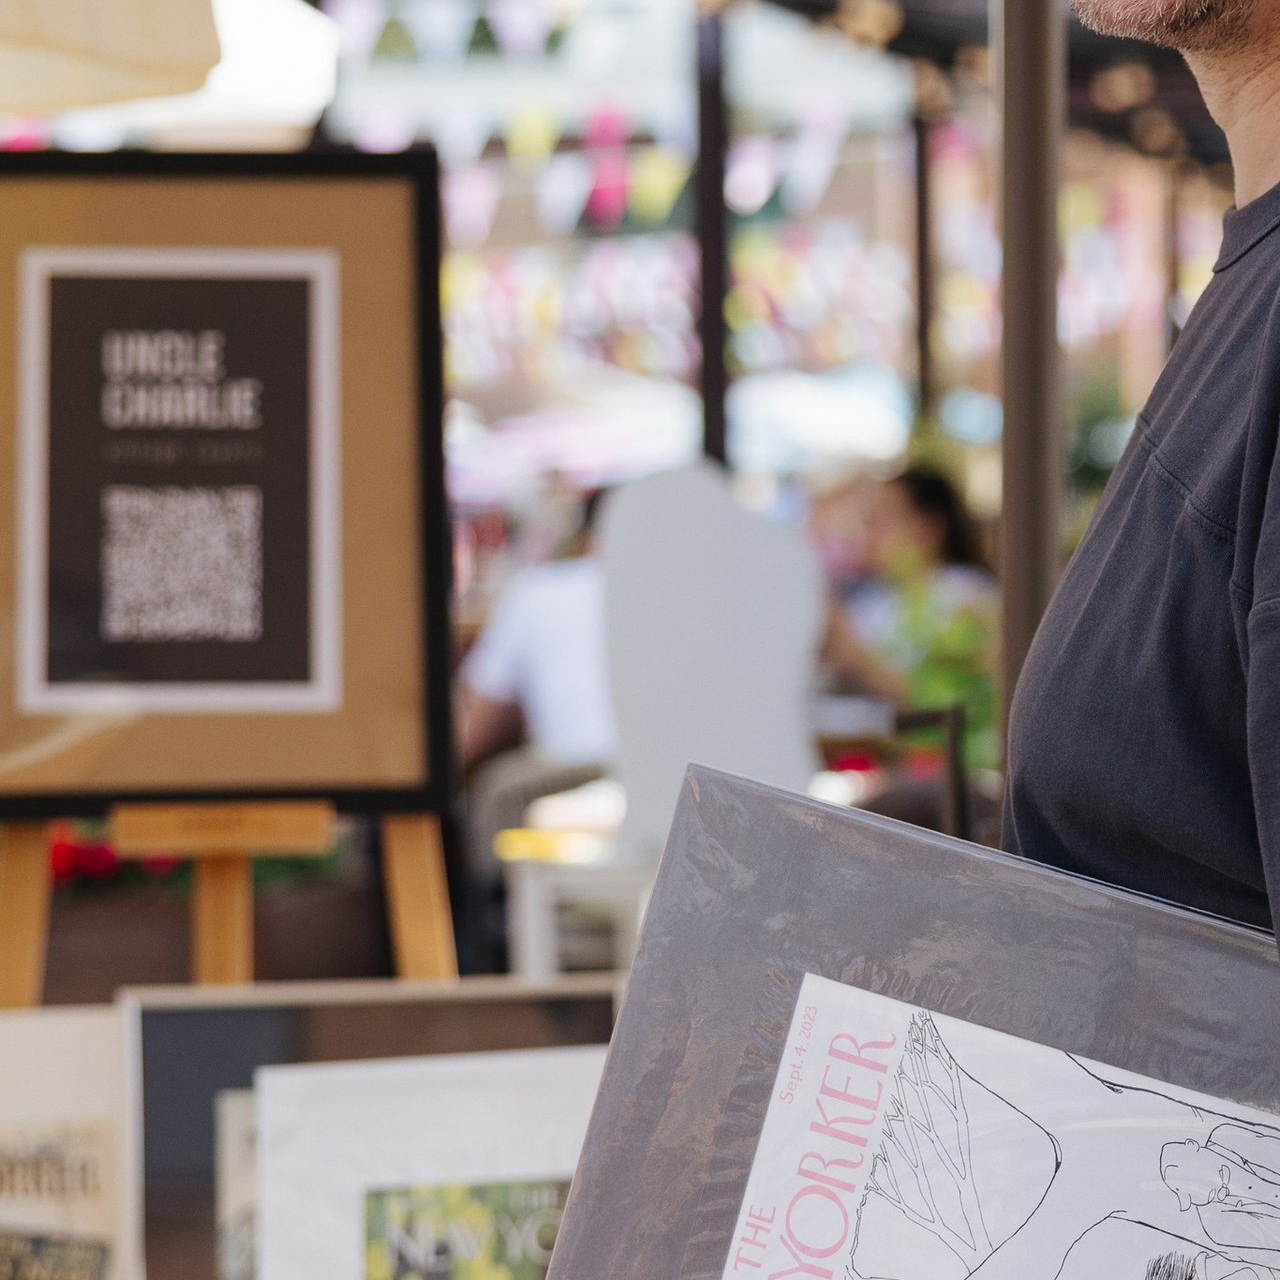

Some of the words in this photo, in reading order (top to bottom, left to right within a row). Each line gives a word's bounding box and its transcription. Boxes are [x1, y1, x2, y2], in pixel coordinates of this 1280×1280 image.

[102, 330, 225, 382] UNCLE
[102, 378, 263, 430] CHARLIE
[779, 1060, 804, 1104] Sept.
[799, 1005, 818, 1039] 2023
[766, 1032, 897, 1280] YORKER
[387, 1216, 497, 1269] NEW
[734, 1205, 777, 1272] THE
